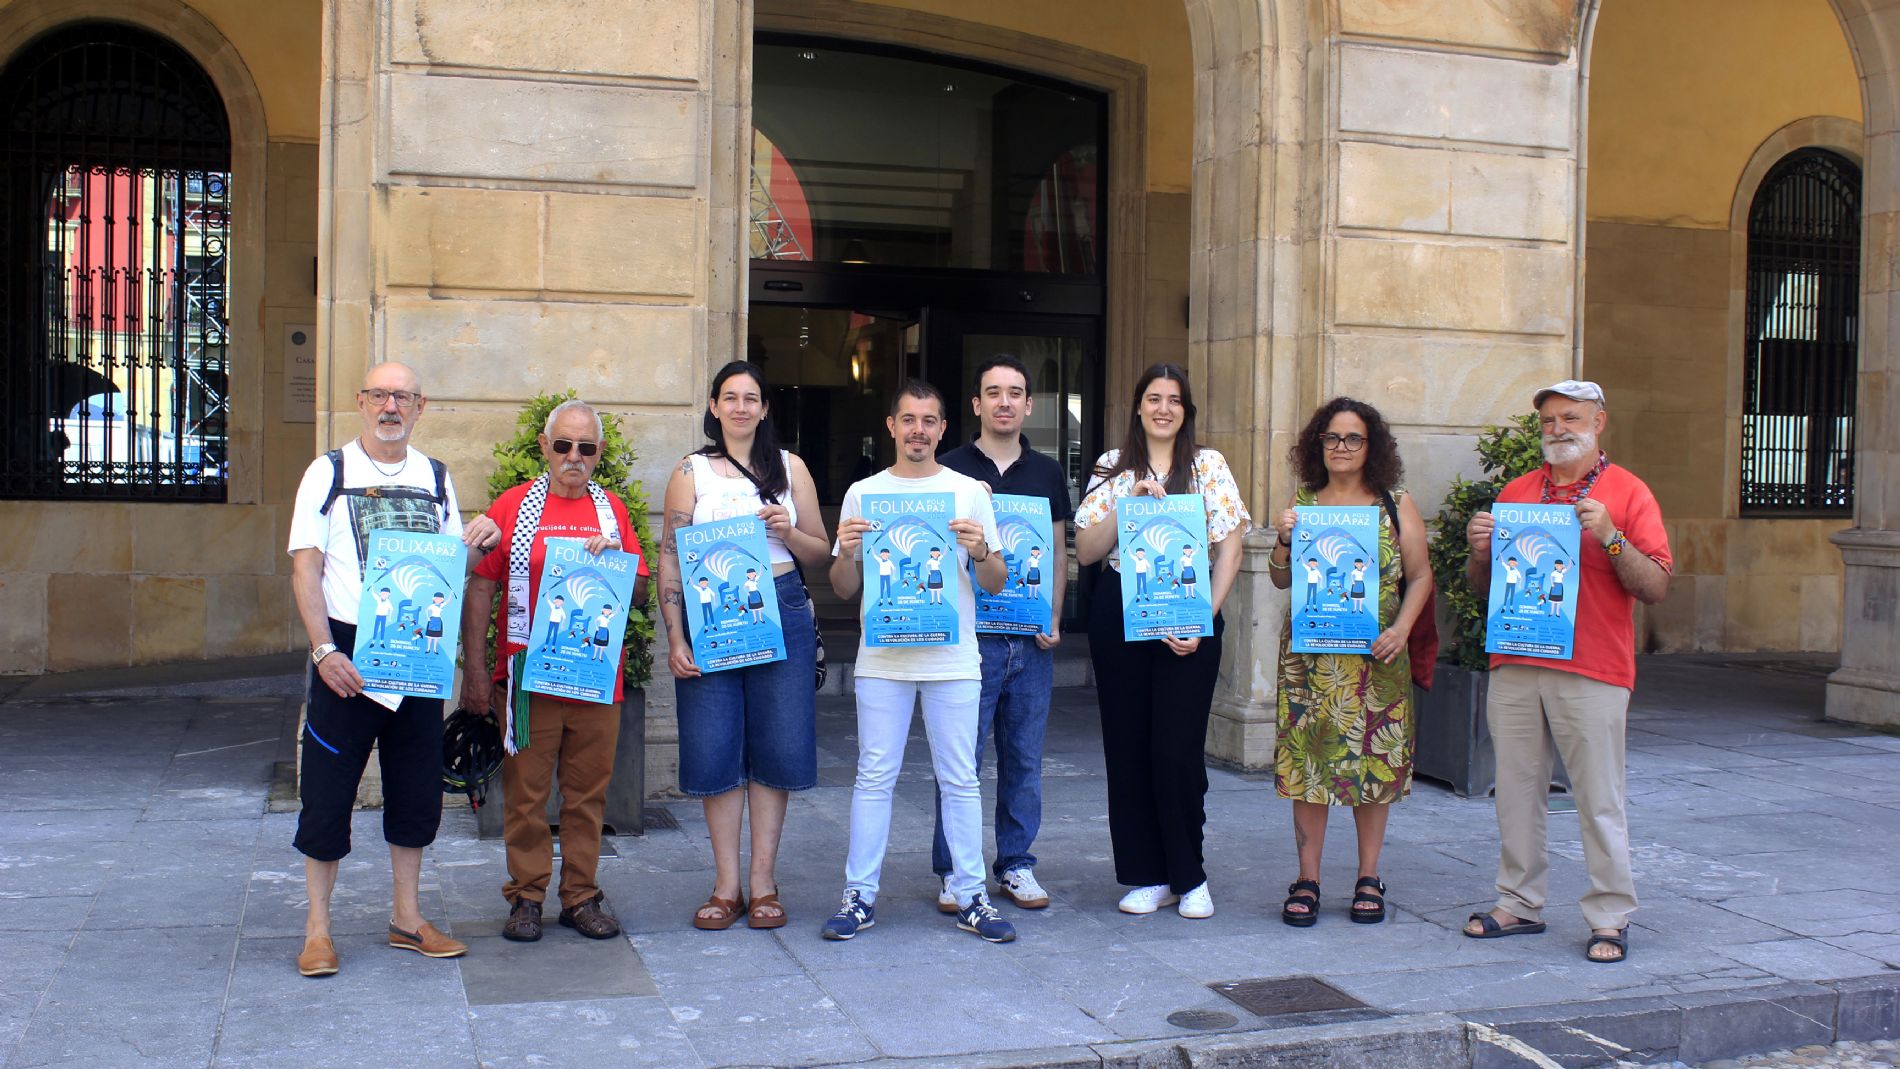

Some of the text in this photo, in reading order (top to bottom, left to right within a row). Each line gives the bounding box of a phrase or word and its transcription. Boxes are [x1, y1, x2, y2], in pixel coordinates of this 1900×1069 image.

[871, 500, 926, 514] FOLIXA
[992, 500, 1029, 514] OLIXA
[1126, 501, 1177, 516] FOLIXA
[1301, 512, 1351, 525] FOLIXA
[1500, 510, 1551, 524] FOLIXA
[1552, 517, 1571, 525] PAZ
[685, 526, 736, 546] FOLIXA
[738, 527, 756, 536] PAZ
[378, 538, 434, 555] FOLIXA
[436, 548, 457, 557] PAZ
[555, 546, 606, 568] FOLIXA
[608, 562, 627, 572] PAZ
